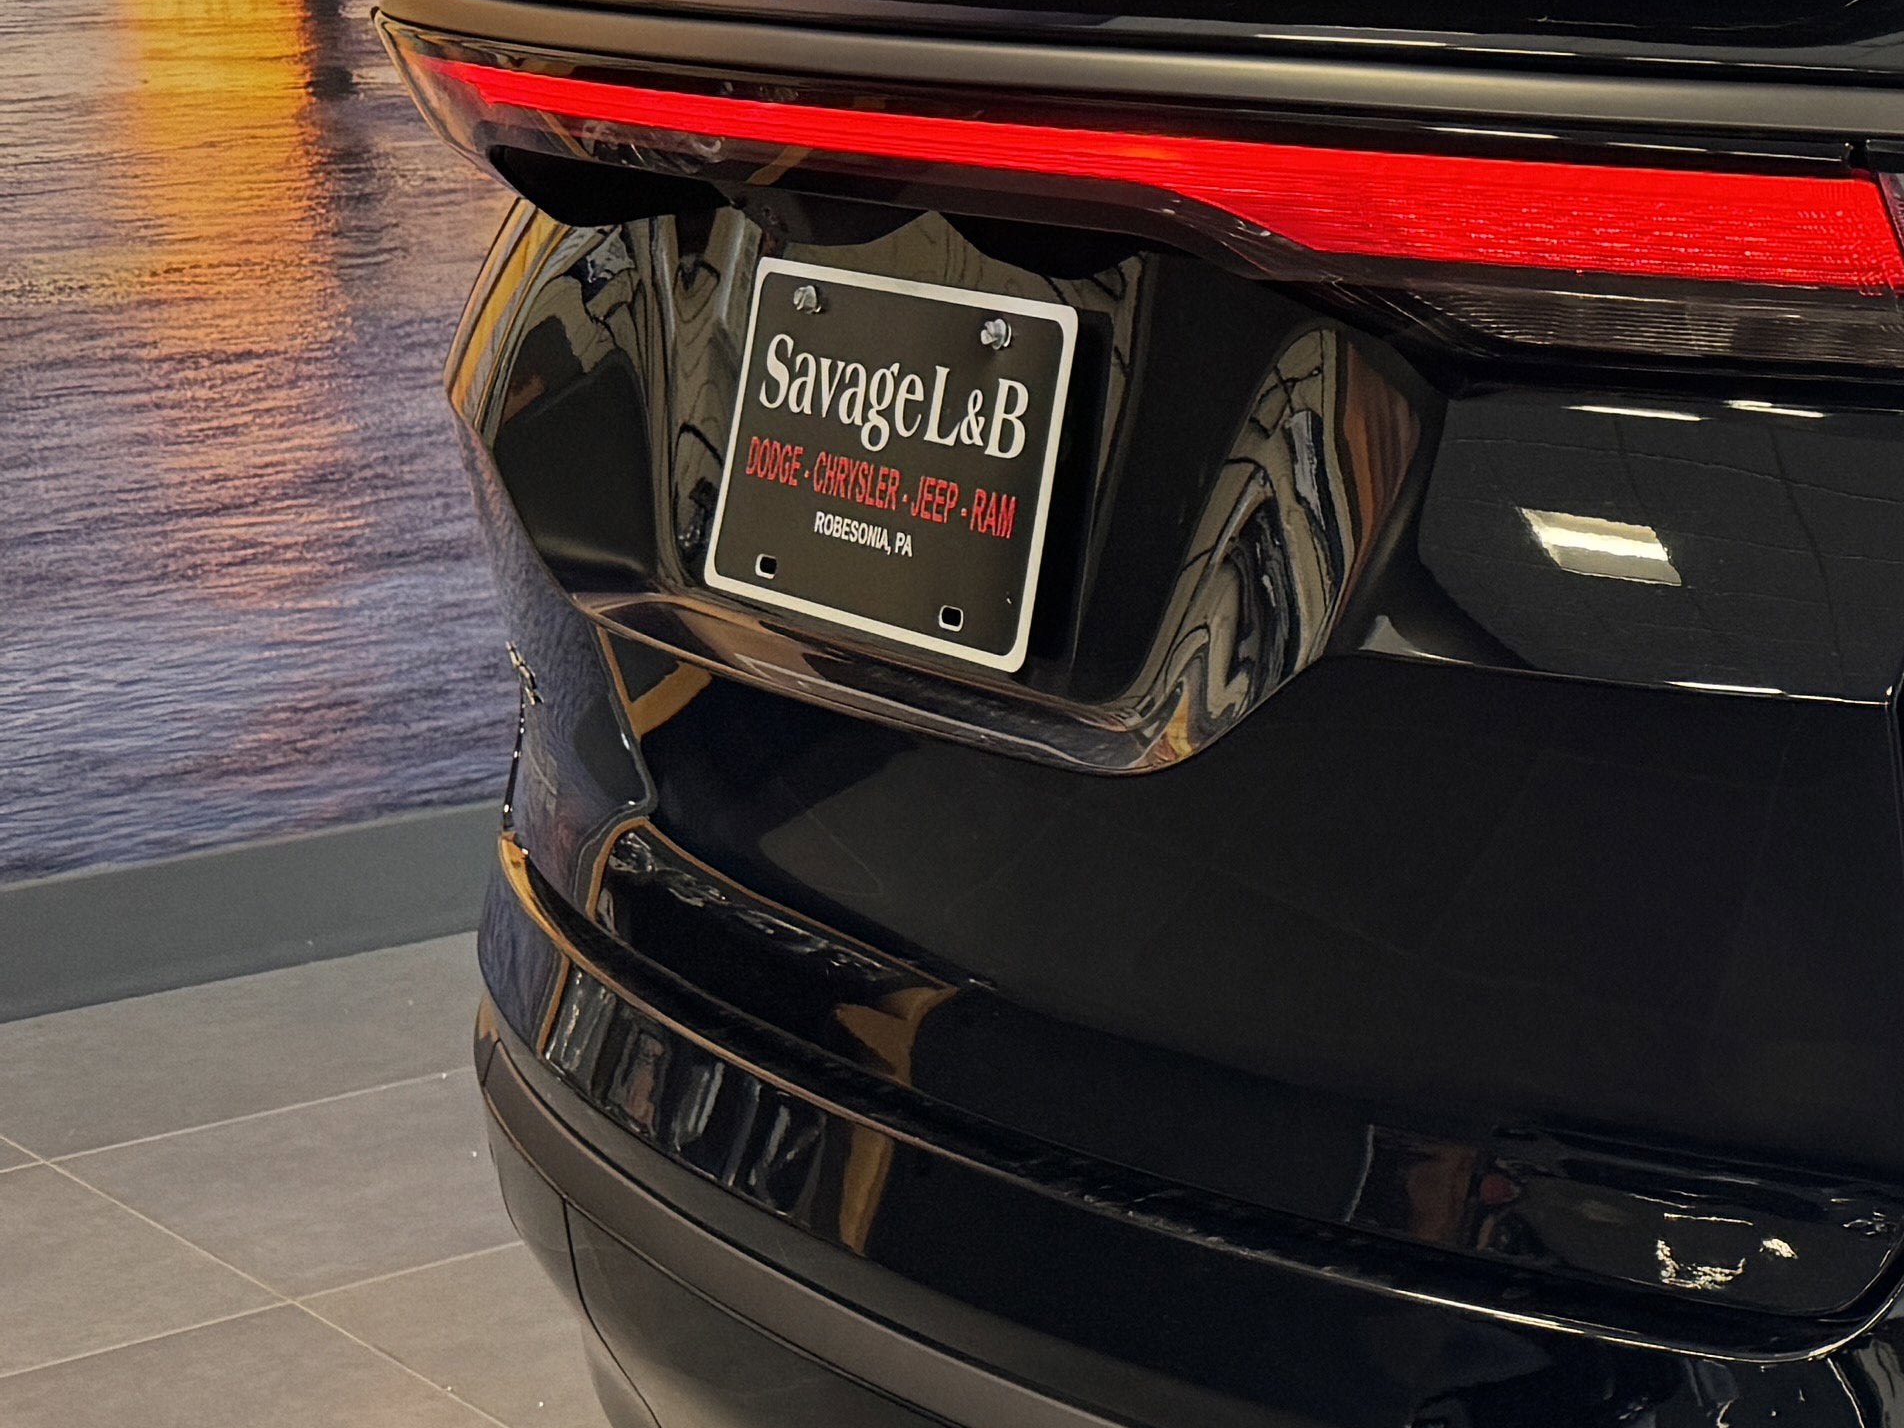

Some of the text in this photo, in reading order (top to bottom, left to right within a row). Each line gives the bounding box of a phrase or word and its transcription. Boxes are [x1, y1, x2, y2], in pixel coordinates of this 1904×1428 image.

[745, 435, 1018, 540] DODGE CHRYSLER JEEP RAM
[813, 510, 914, 558] ROBESONIA, PA
